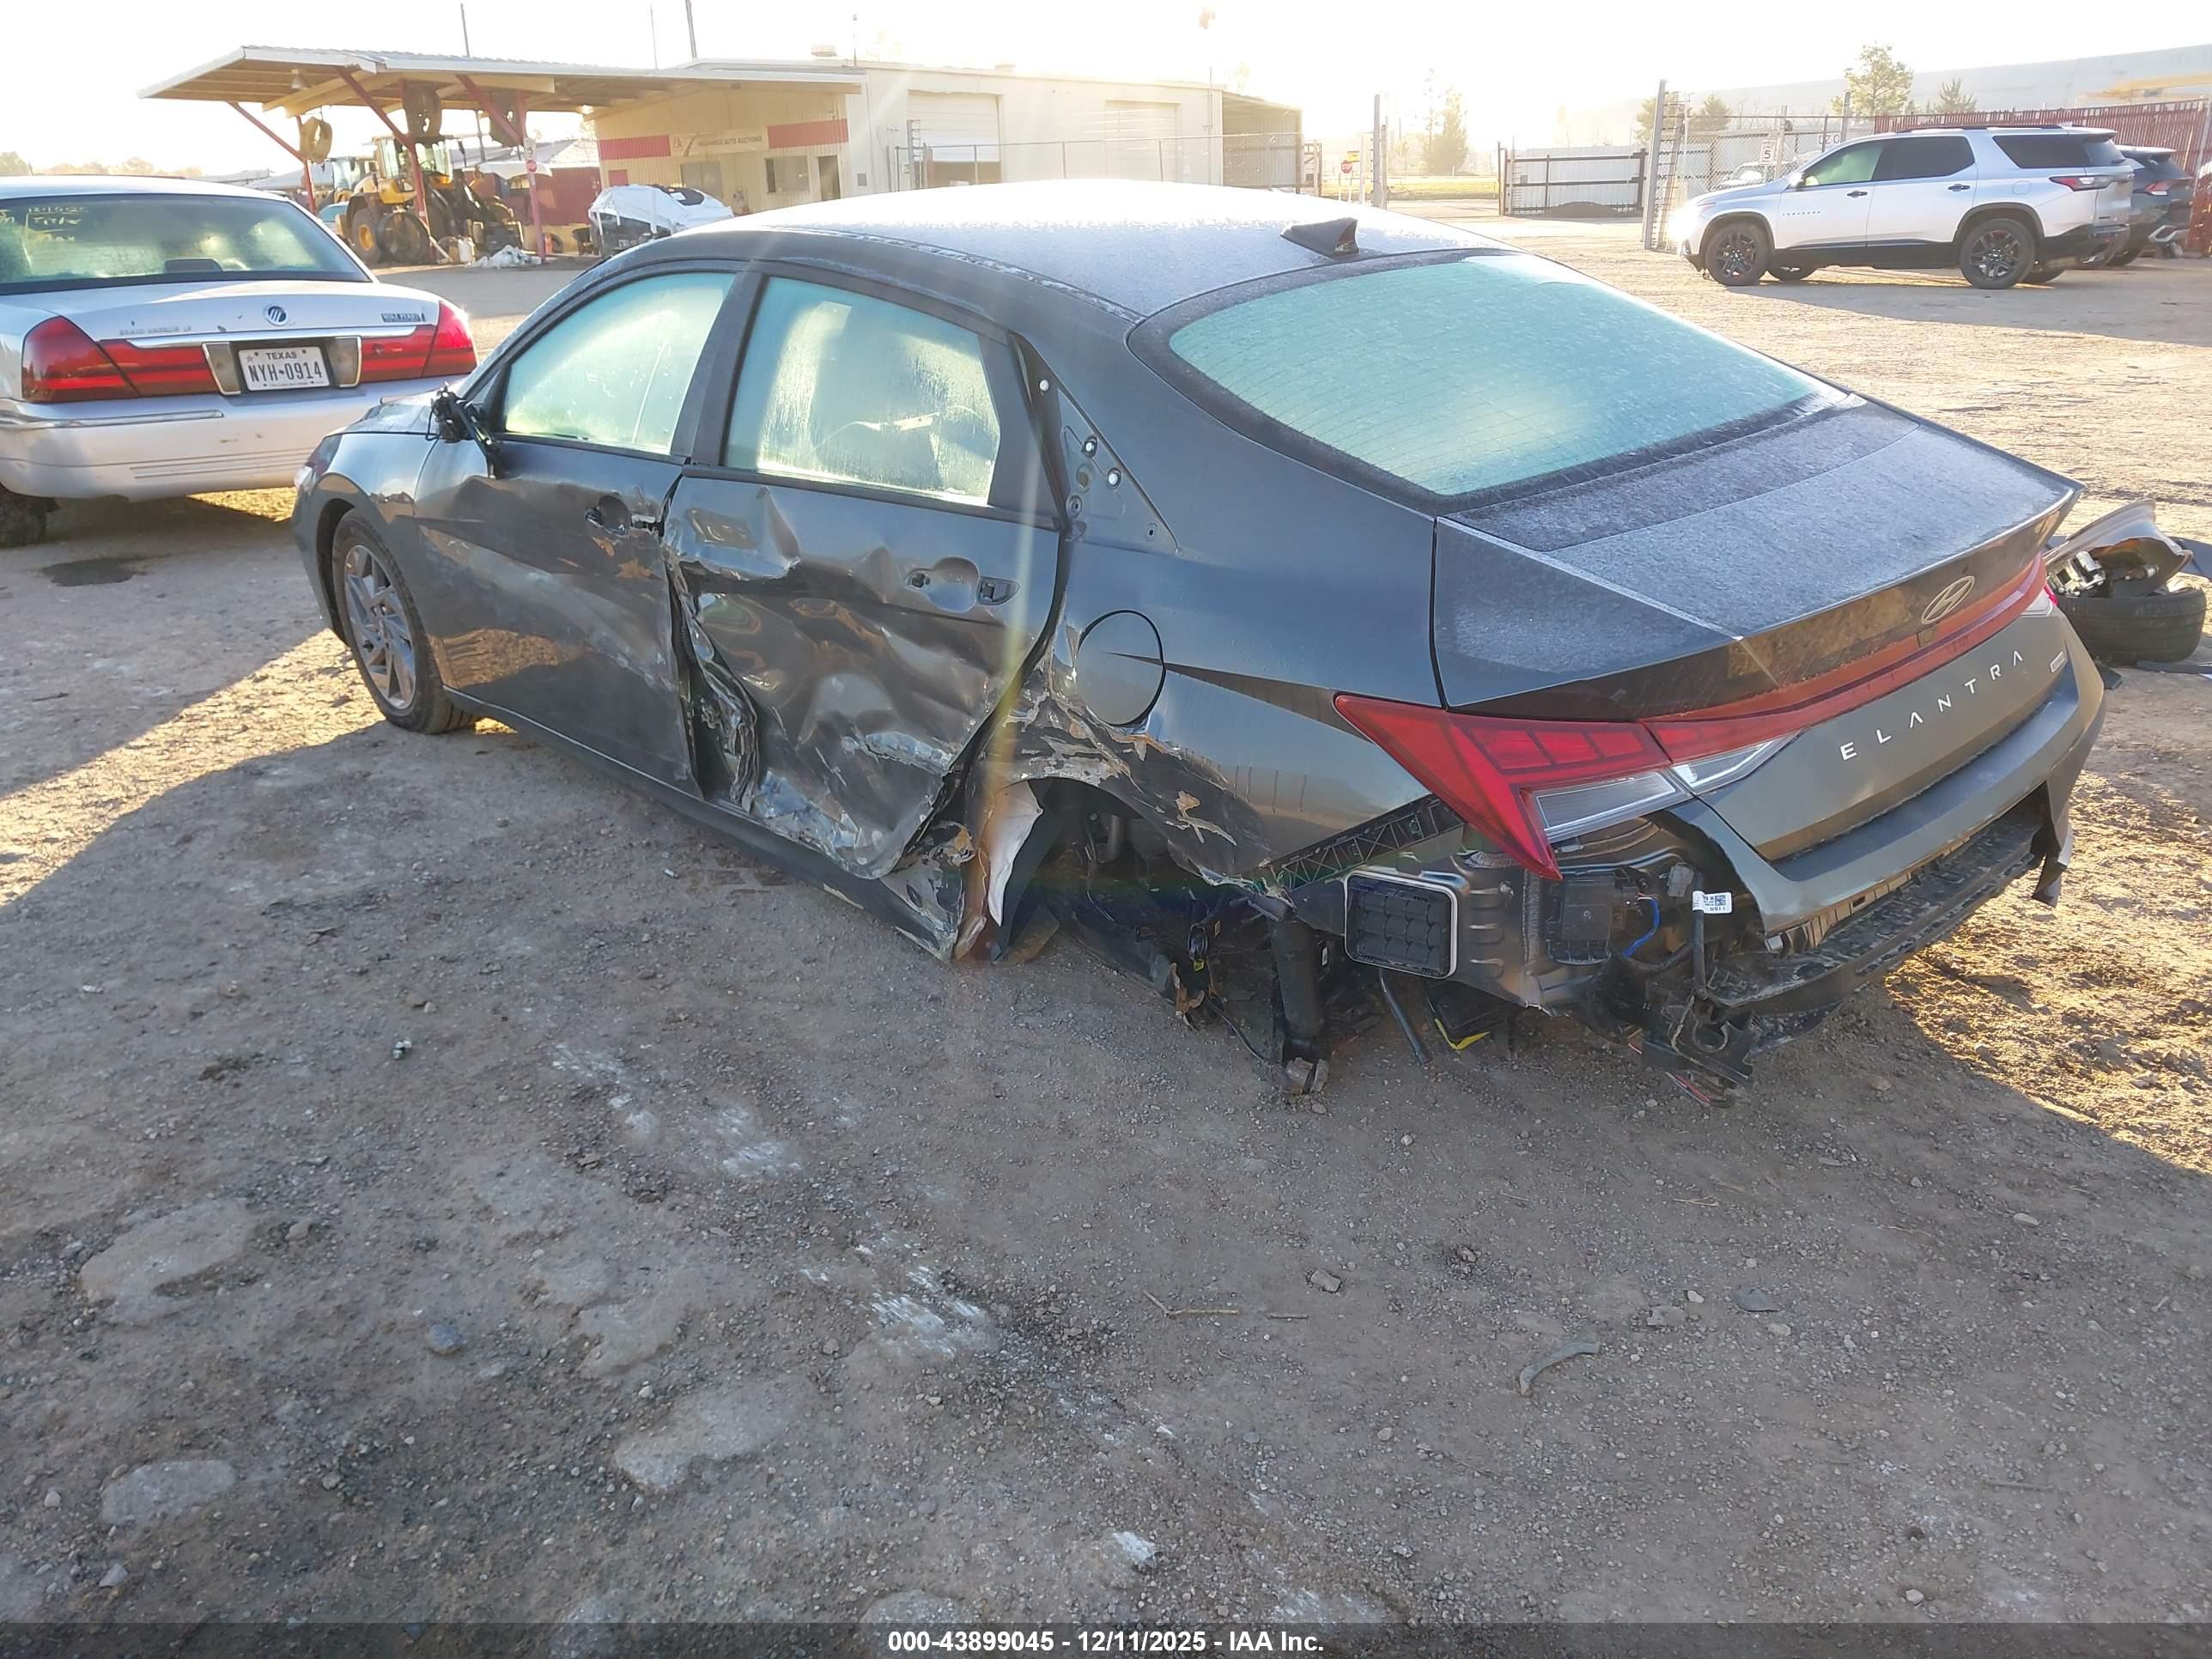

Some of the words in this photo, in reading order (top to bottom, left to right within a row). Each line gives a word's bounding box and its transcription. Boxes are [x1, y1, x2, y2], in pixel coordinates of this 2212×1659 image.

[1764, 149, 1771, 160] 5
[265, 351, 297, 361] TEXAS
[1840, 650, 2024, 762] ELANTRA
